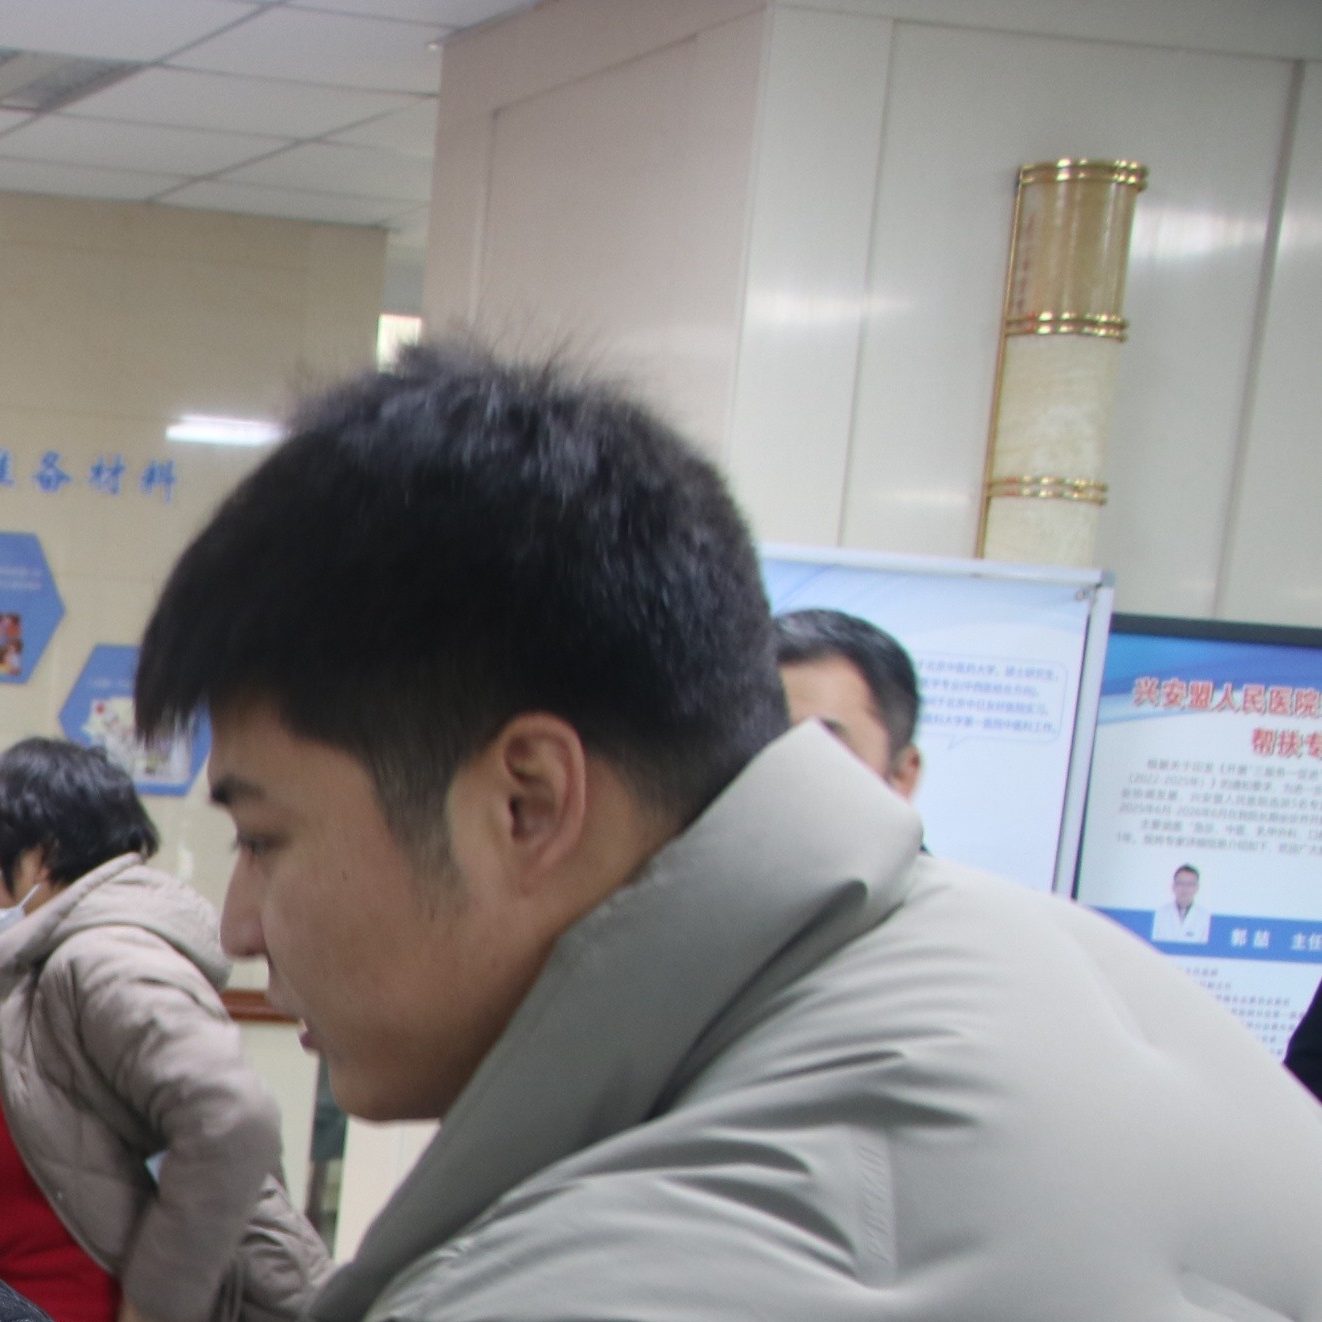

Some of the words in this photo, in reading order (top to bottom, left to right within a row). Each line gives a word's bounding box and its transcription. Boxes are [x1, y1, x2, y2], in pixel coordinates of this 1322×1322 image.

[1134, 676, 1320, 717] 兴安盟人民医院
